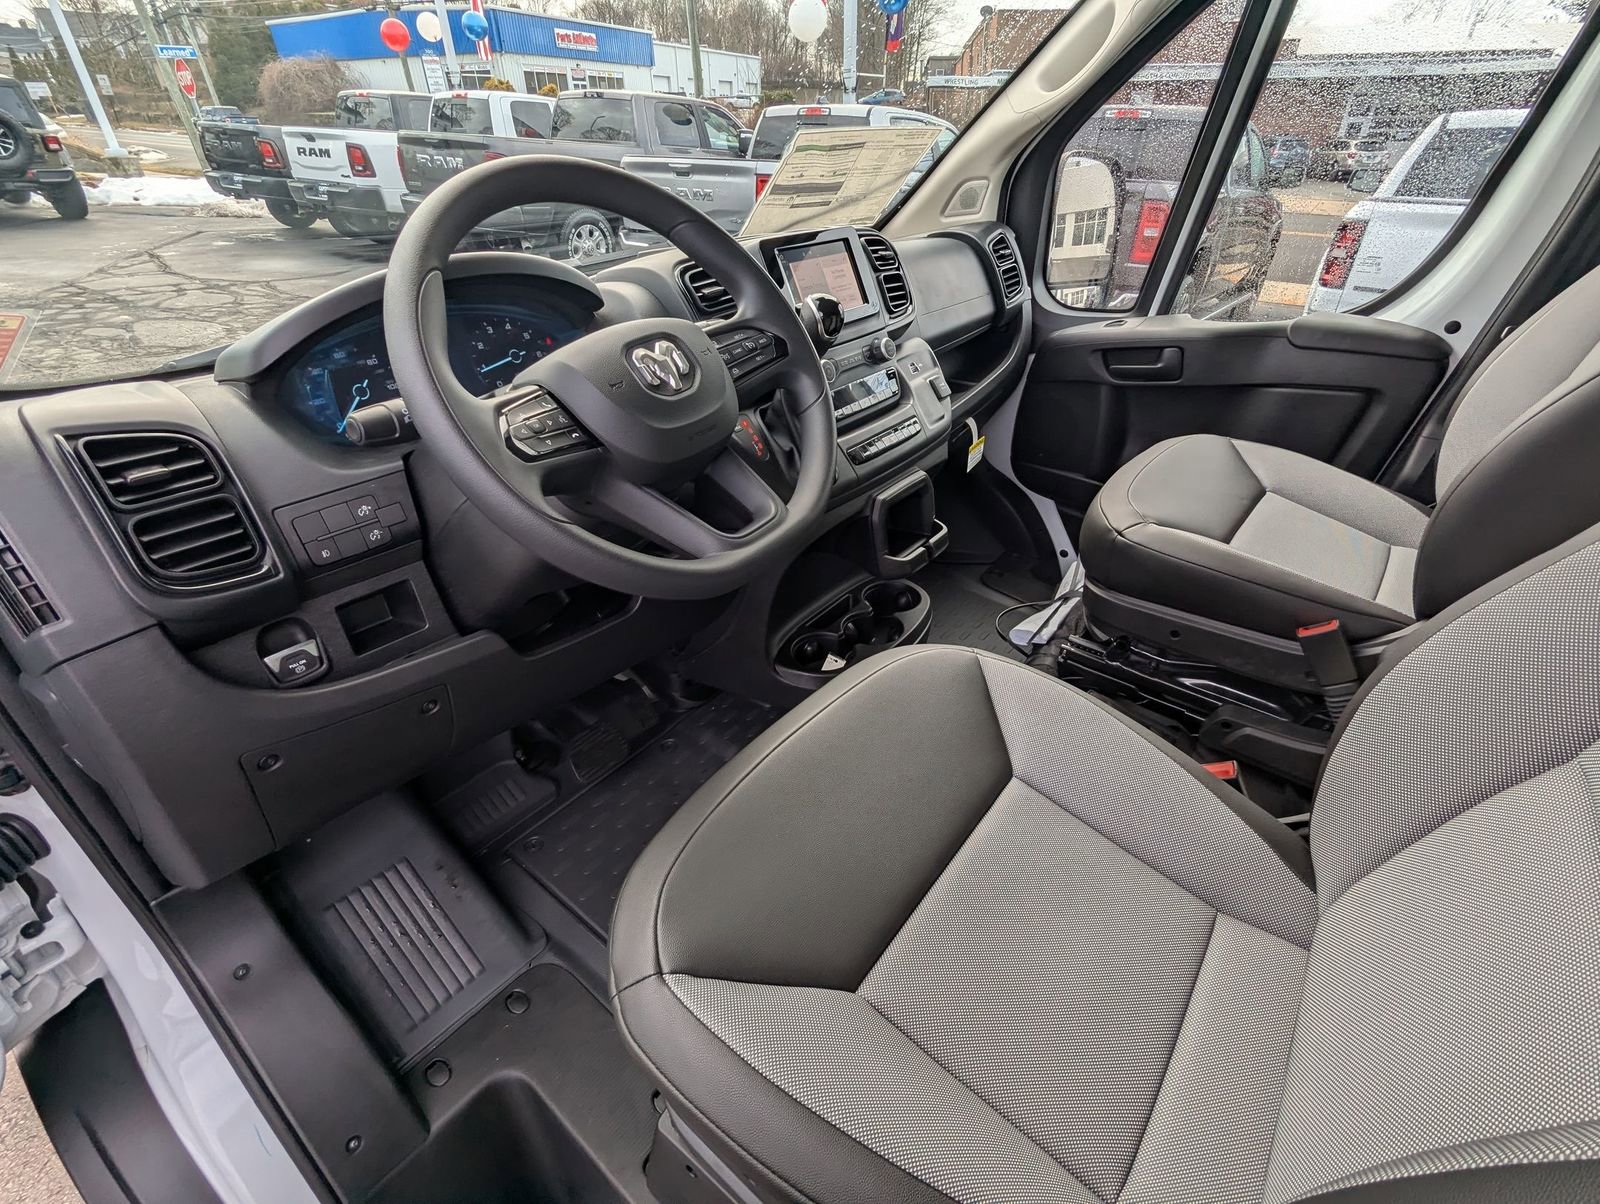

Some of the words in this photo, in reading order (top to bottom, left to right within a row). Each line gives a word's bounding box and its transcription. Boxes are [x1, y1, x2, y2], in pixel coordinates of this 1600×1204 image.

[159, 48, 190, 57] Learned
[177, 70, 193, 86] STOP
[296, 146, 331, 158] RAM
[416, 153, 464, 170] RAM
